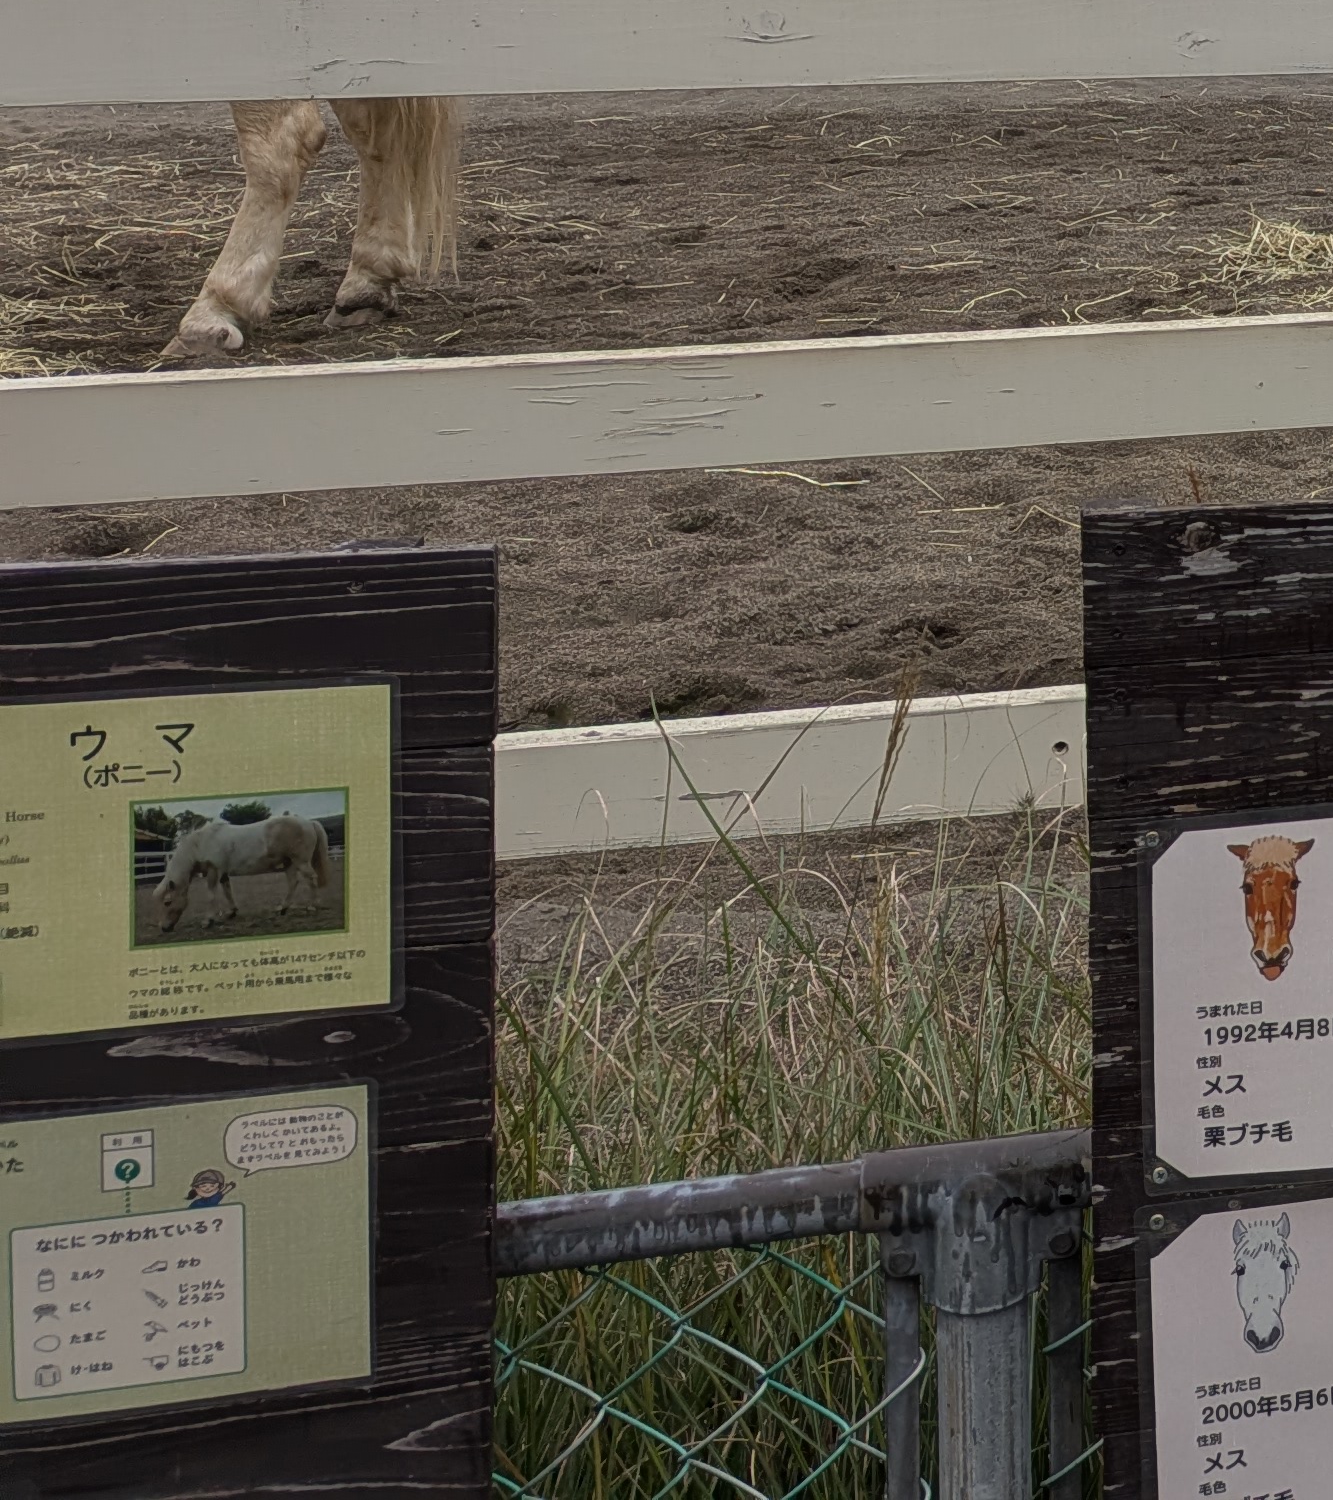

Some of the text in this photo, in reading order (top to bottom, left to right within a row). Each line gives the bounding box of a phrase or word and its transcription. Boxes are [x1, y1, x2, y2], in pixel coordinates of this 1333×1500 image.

[83, 759, 182, 789] (ポニー)
[5, 811, 45, 823] Horse
[1195, 1000, 1263, 1018] うまれた日
[1196, 1054, 1222, 1070] 性別
[1202, 1073, 1247, 1097] メス
[1196, 1104, 1226, 1120] 毛色
[1203, 1119, 1293, 1149] 栗ブチ毛
[35, 1234, 86, 1252] なにに
[176, 1257, 201, 1269] かわ
[69, 1268, 105, 1281] ミルク
[178, 1278, 225, 1294] じっけん
[69, 1300, 92, 1313] にく
[177, 1291, 225, 1306] どうぶつ
[177, 1317, 213, 1329] ペット
[69, 1329, 107, 1345] たまご
[177, 1340, 225, 1356] にもつを
[177, 1353, 214, 1368] はこぶ
[1194, 1376, 1261, 1400] うまれた日
[1196, 1431, 1222, 1448] 性別
[1203, 1449, 1248, 1474] メス
[1198, 1480, 1227, 1497] 毛色
